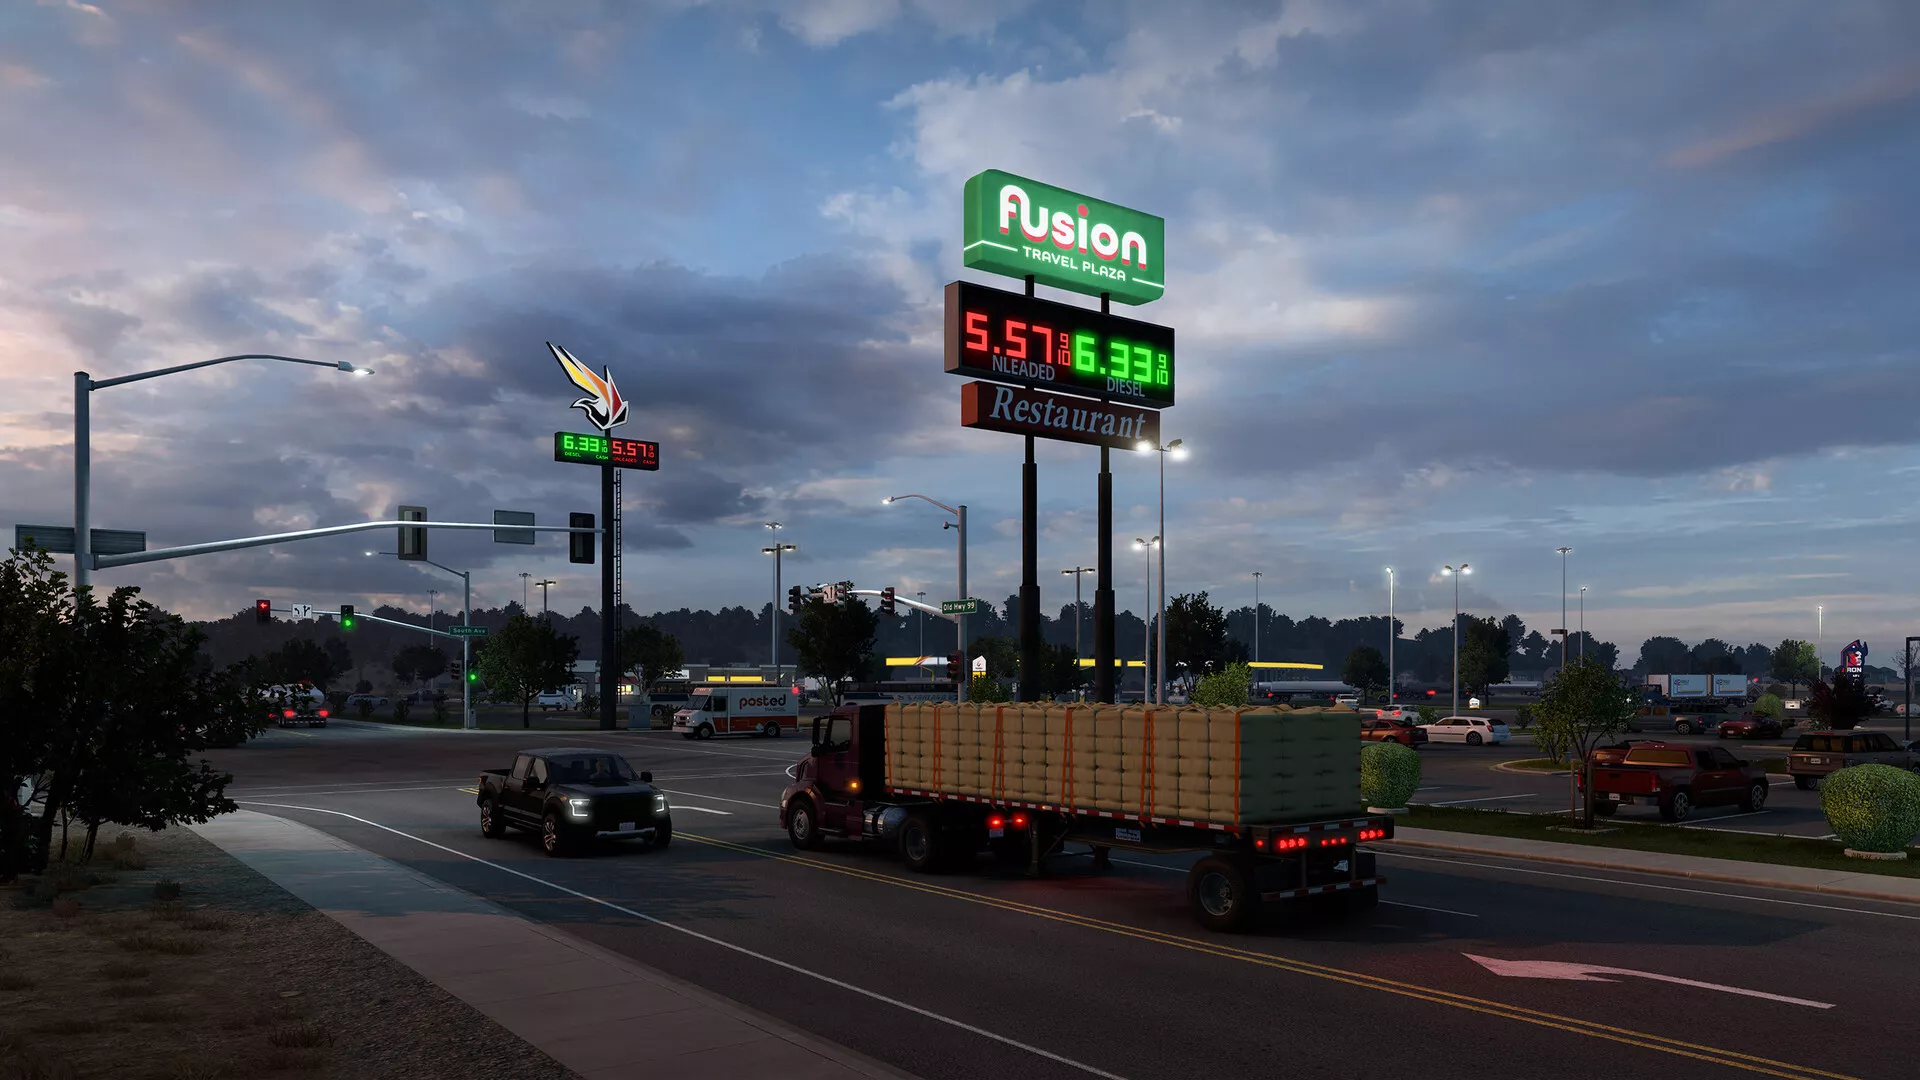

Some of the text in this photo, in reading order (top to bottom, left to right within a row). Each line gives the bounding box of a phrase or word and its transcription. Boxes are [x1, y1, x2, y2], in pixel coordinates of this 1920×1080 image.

[1022, 245, 1126, 282] TRAVEL PLAZA
[966, 311, 1052, 364] 5.57
[1076, 334, 1152, 383] 6.33
[1106, 375, 1146, 398] DIESEL
[990, 386, 1146, 440] Restaurant
[564, 435, 599, 452] 6.33
[612, 440, 647, 457] 5.57
[943, 601, 975, 611] Old Hwy 99
[739, 693, 787, 710] posted
